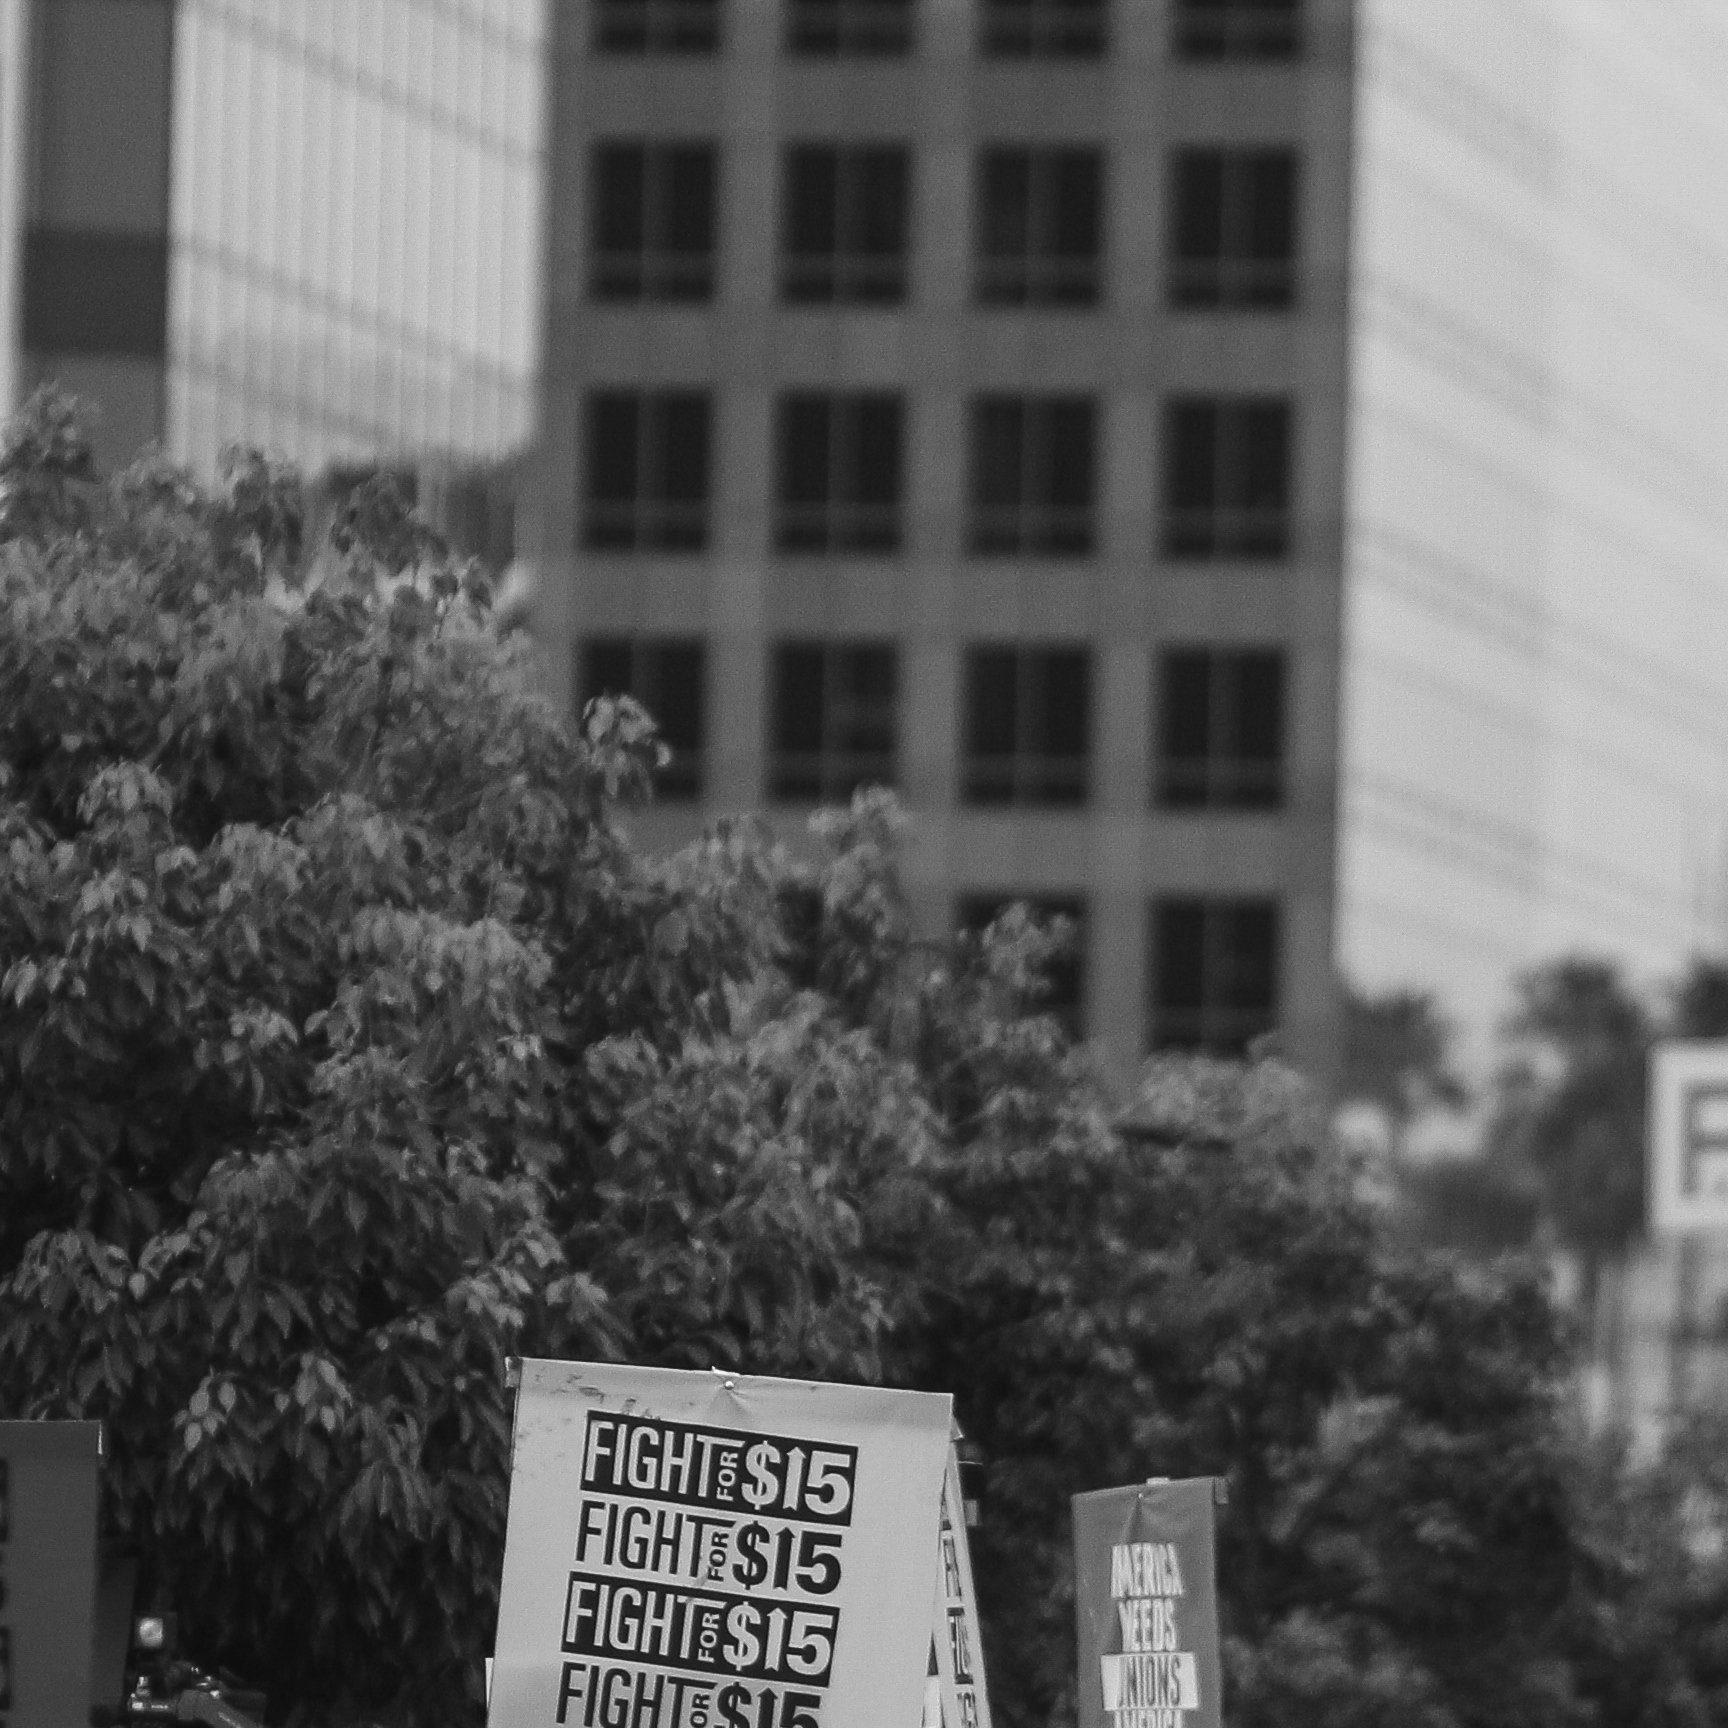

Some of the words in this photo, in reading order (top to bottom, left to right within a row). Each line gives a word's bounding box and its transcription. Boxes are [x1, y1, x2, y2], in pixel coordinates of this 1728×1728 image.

[585, 1420, 746, 1497] FIGHT
[716, 1450, 738, 1501] FOR
[741, 1440, 850, 1515] $15
[575, 1499, 736, 1578] FIGHT
[707, 1530, 729, 1582] FOR
[732, 1520, 843, 1595] $15
[1111, 1542, 1184, 1598] AMERICA
[566, 1580, 727, 1659] FIGHT
[698, 1611, 720, 1663] FOR
[722, 1601, 834, 1675] $15
[1118, 1598, 1177, 1651] NEEDS
[1119, 1655, 1180, 1708] UNIONS
